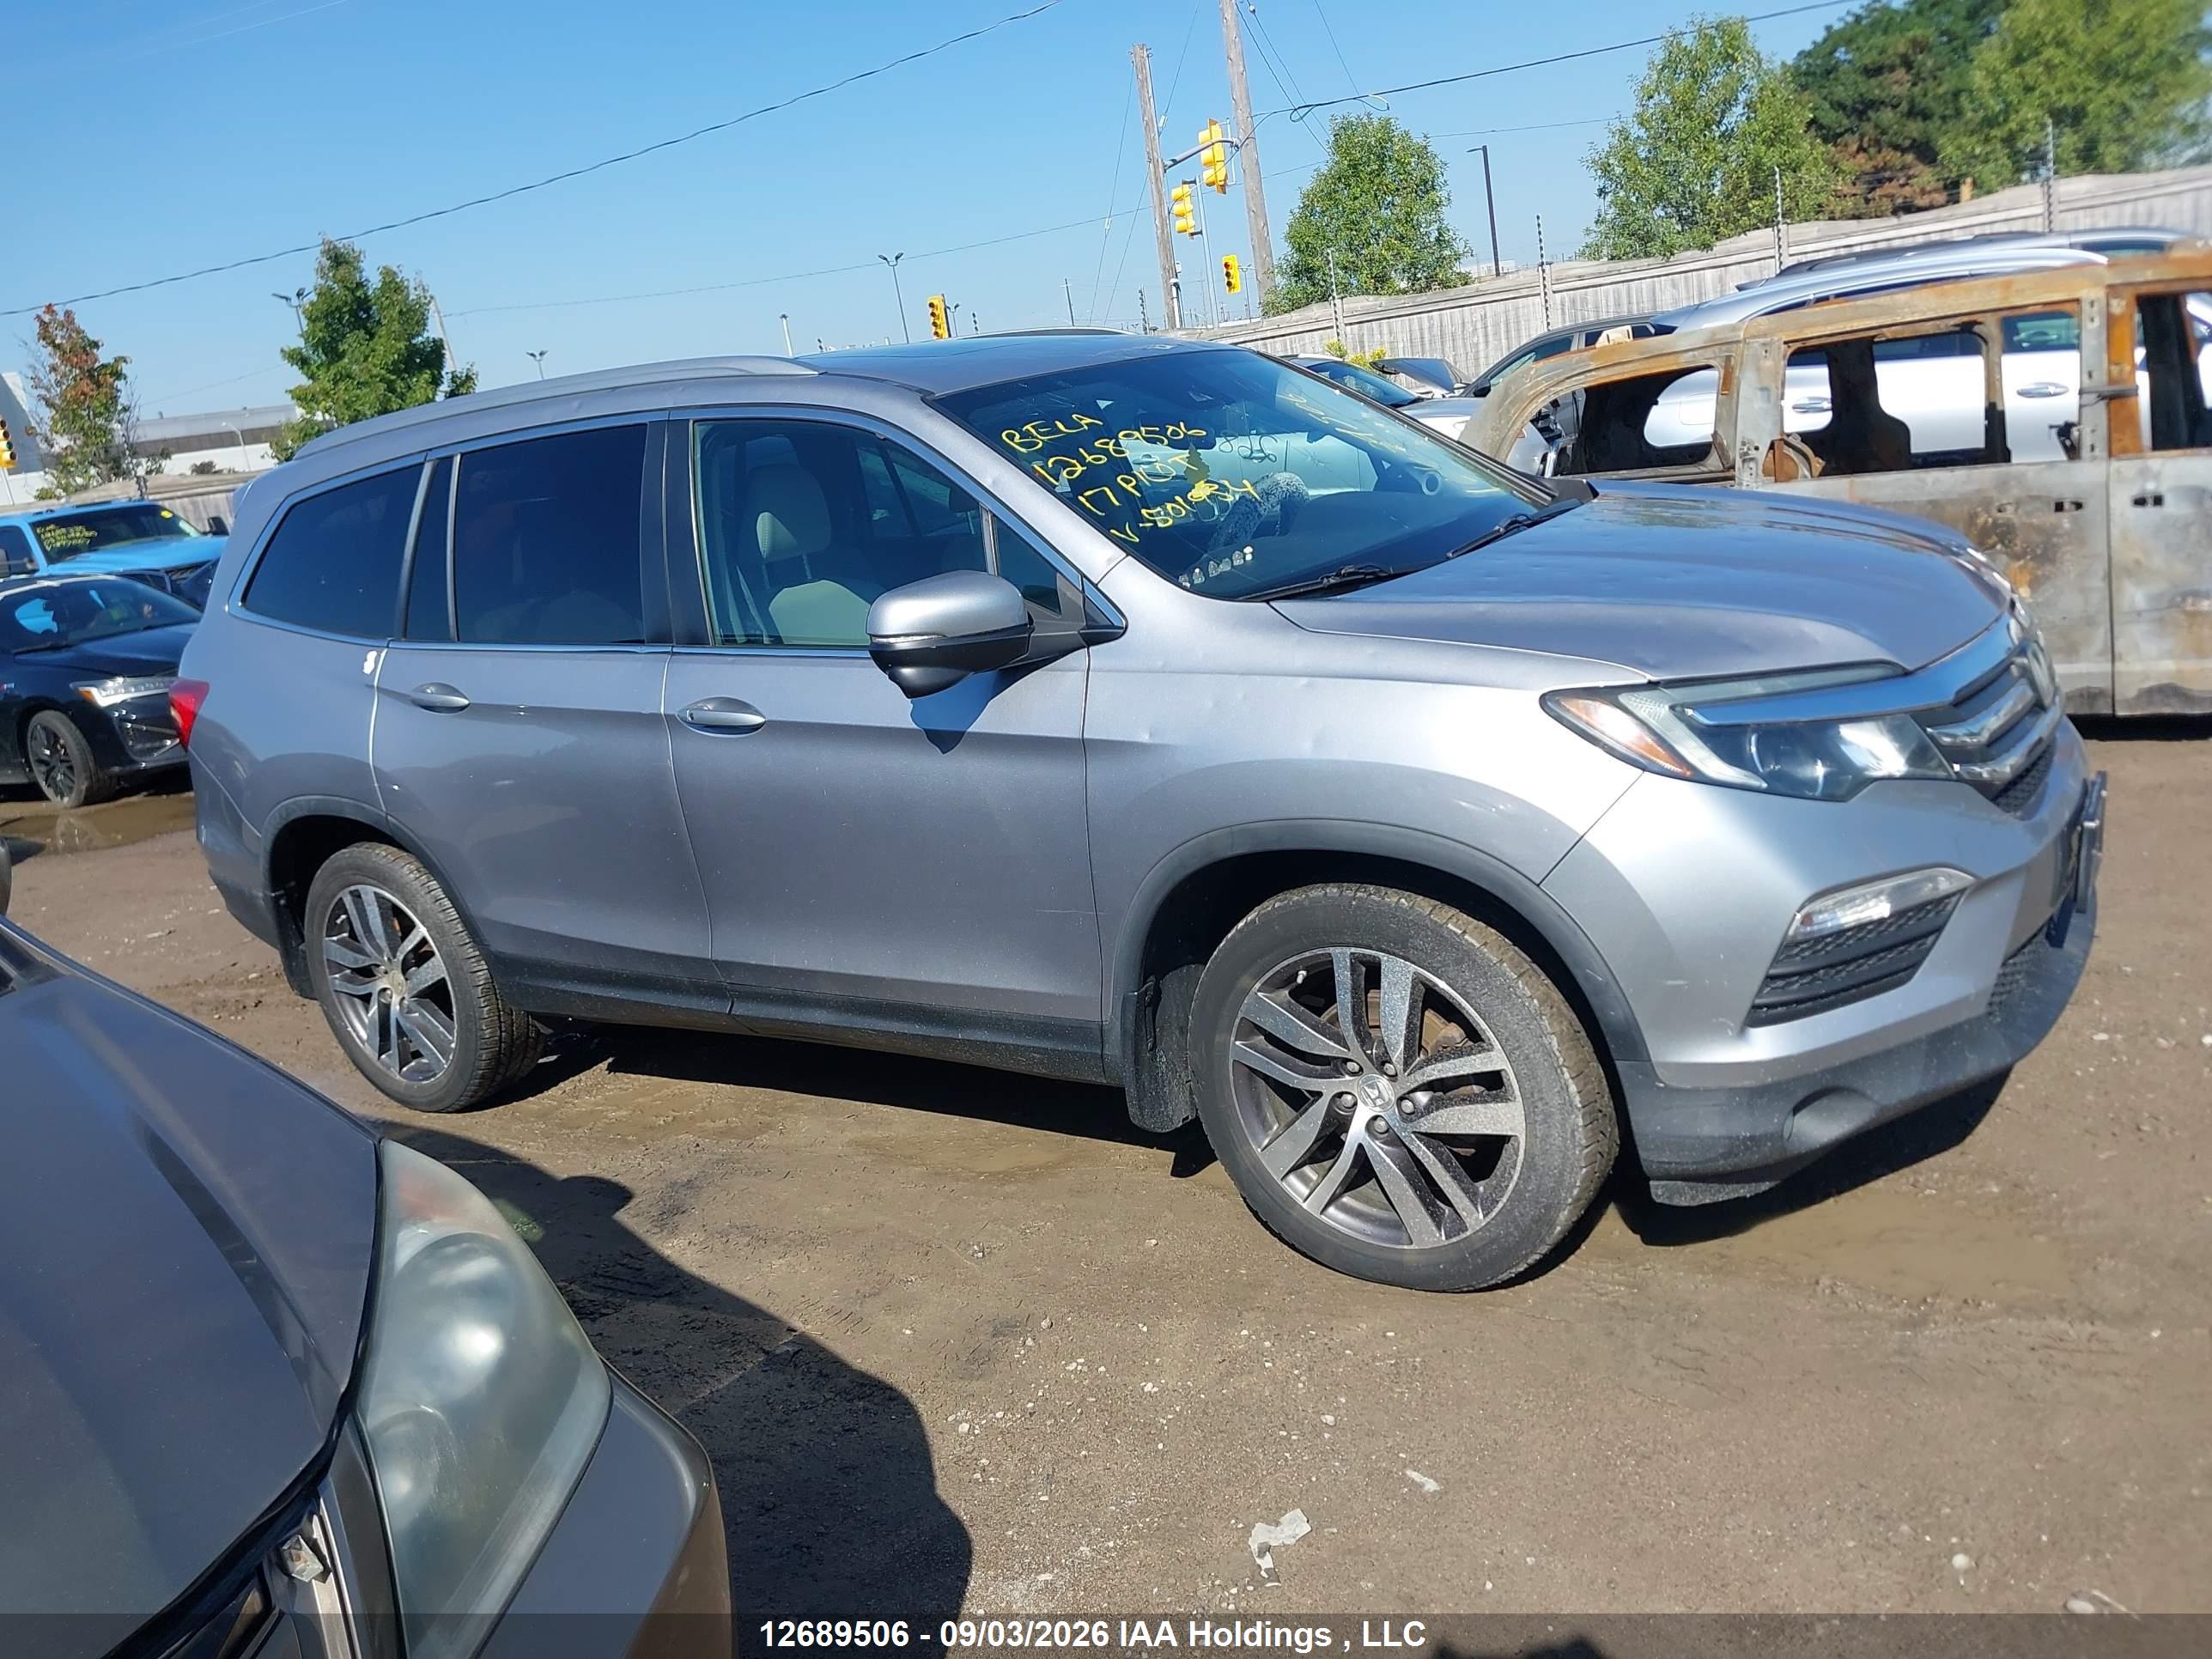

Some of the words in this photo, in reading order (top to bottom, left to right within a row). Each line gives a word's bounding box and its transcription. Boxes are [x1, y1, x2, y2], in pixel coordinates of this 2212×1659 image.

[1001, 414, 1104, 453] BELA
[1031, 421, 1207, 486] 12689506
[1078, 486, 1122, 516] 17
